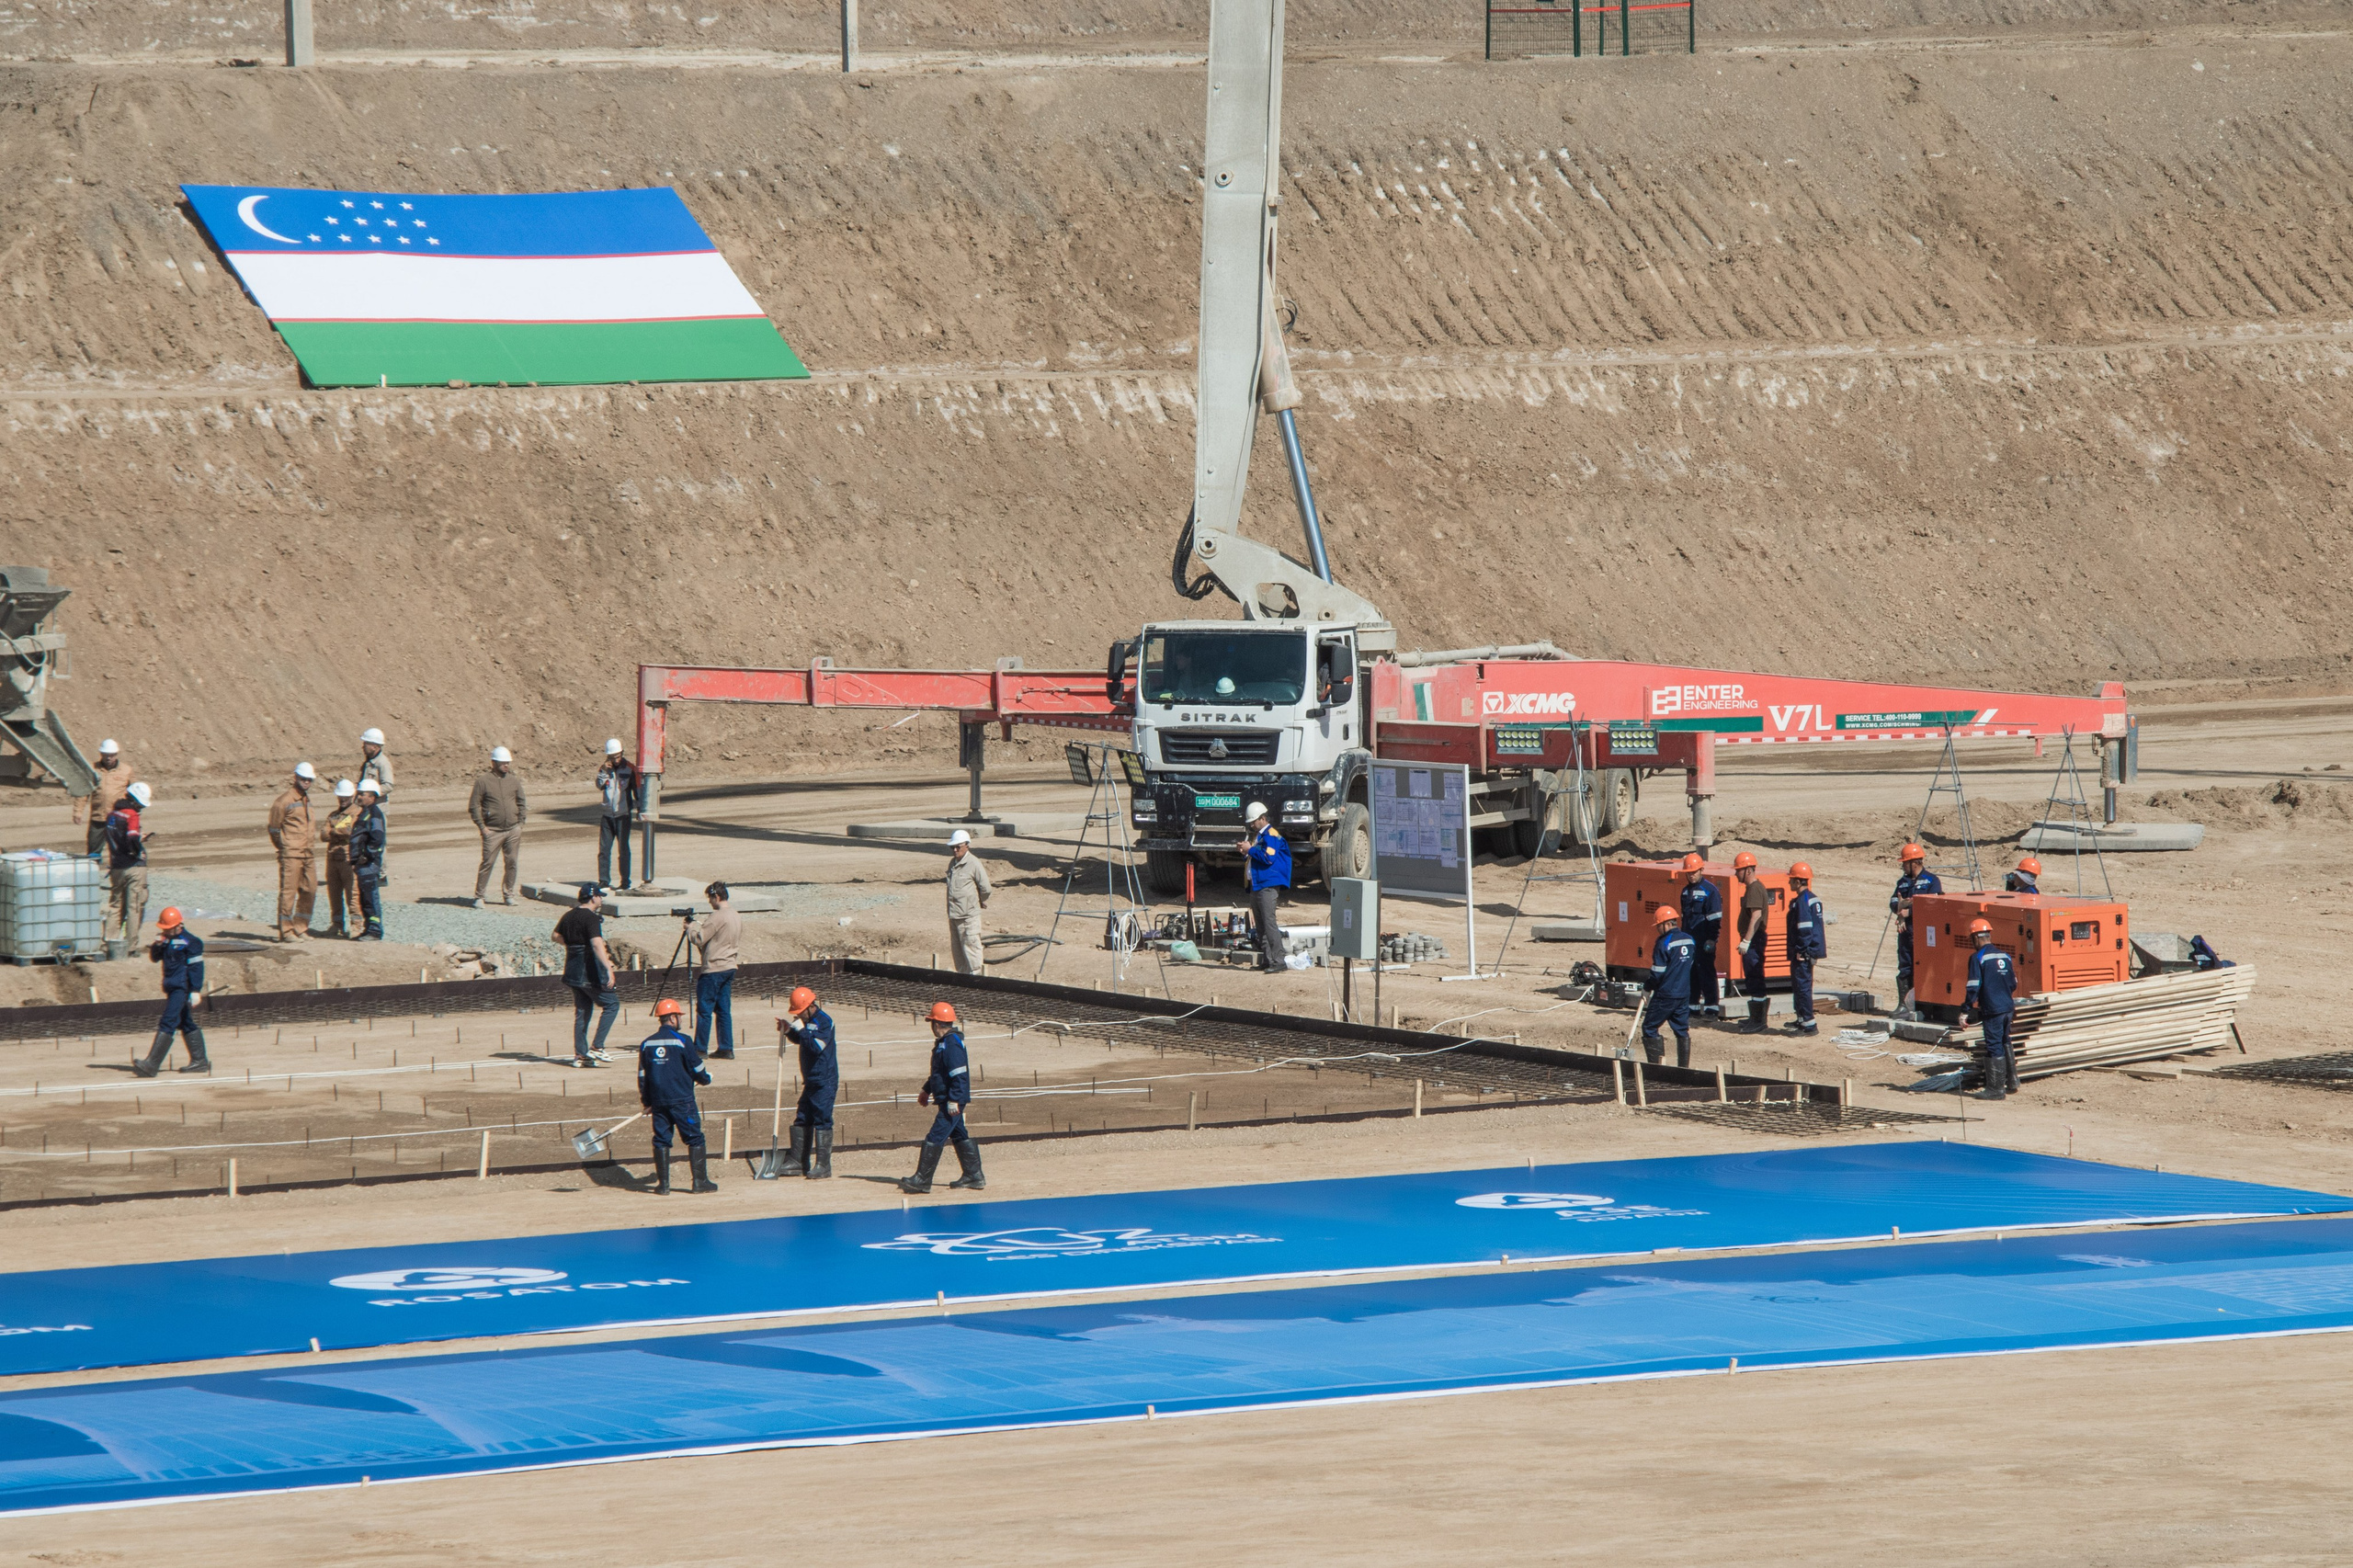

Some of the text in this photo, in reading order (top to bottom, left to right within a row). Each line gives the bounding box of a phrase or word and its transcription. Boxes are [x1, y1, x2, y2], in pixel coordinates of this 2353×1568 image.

[1683, 684, 1744, 700] ENTER
[1503, 691, 1576, 714] XCMG
[1683, 699, 1758, 710] ENGINEERING
[1181, 713, 1256, 722] SITRAK
[1767, 704, 1833, 732] V7L
[367, 1278, 691, 1306] ROSATOM
